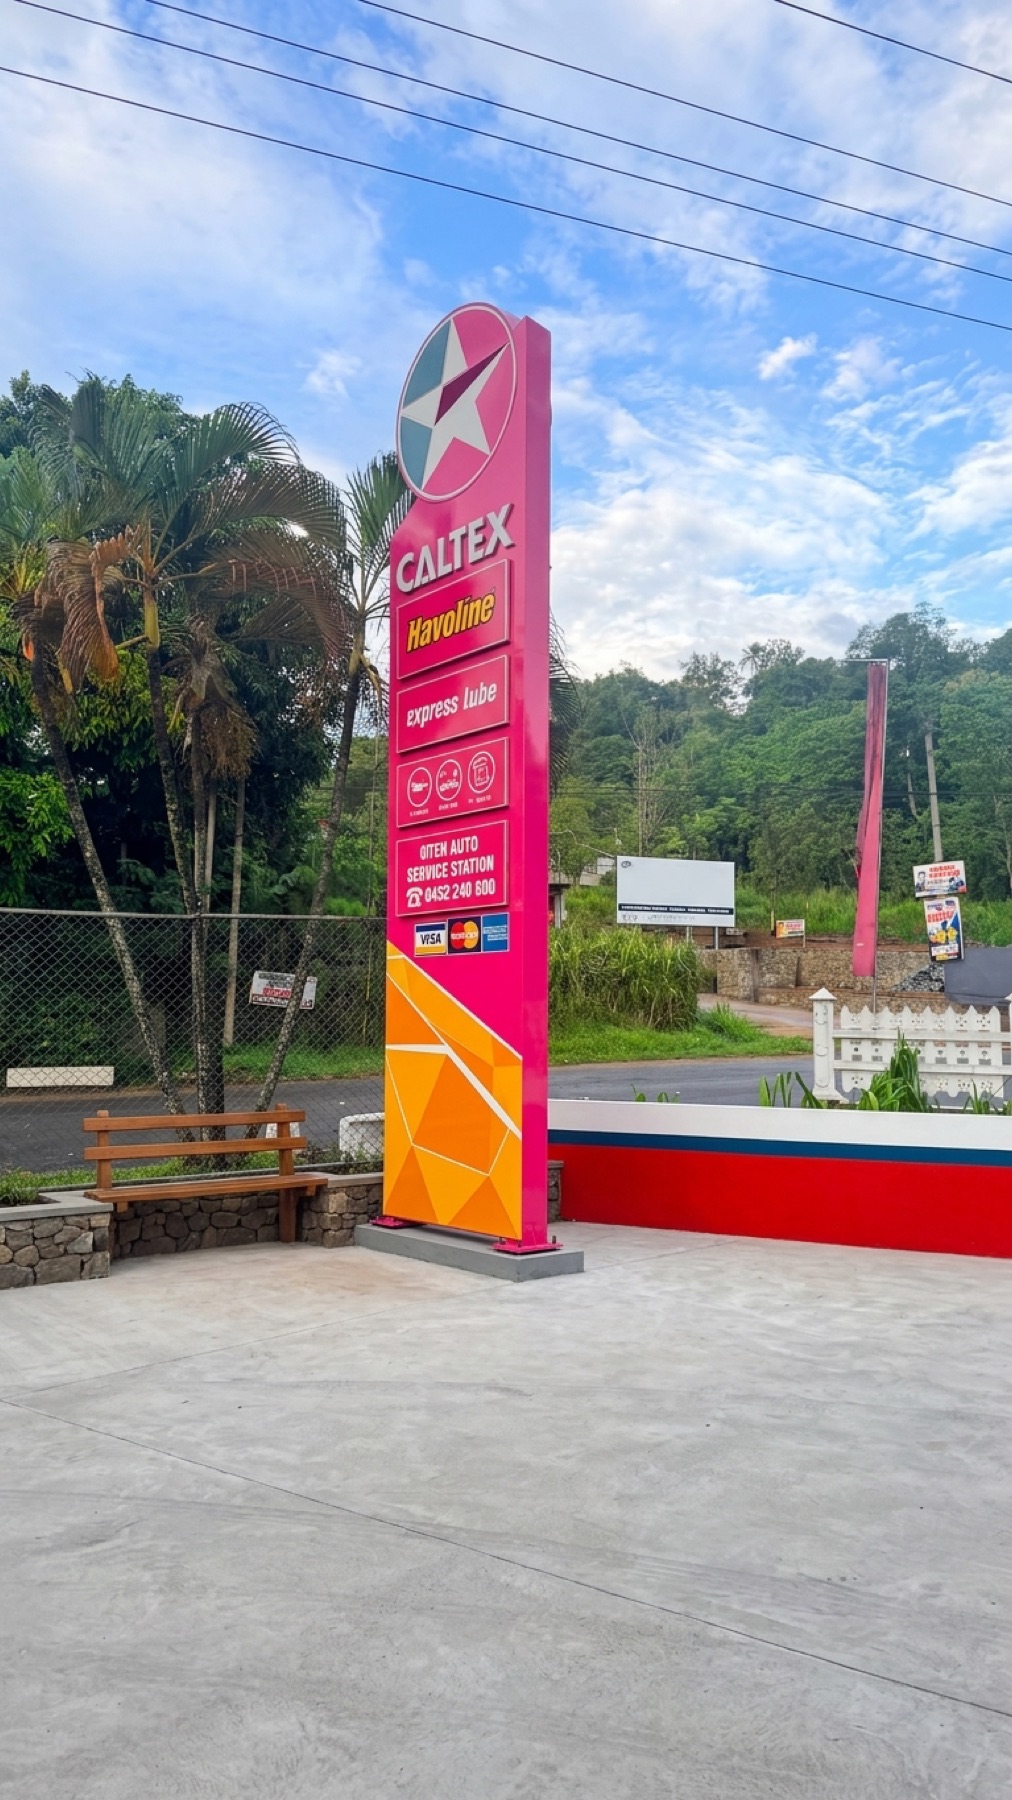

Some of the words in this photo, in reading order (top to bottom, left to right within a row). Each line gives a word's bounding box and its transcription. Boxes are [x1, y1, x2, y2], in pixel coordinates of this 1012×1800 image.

[396, 503, 515, 593] CALTEX
[406, 590, 495, 653] Havoline
[407, 695, 459, 728] express
[463, 682, 497, 710] lube
[450, 835, 479, 856] AUTO
[406, 861, 449, 883] SERVICE
[450, 854, 495, 877] STATION
[424, 884, 450, 903] 0452
[452, 881, 472, 900] 240
[475, 877, 496, 897] 600
[420, 933, 442, 945] VISA
